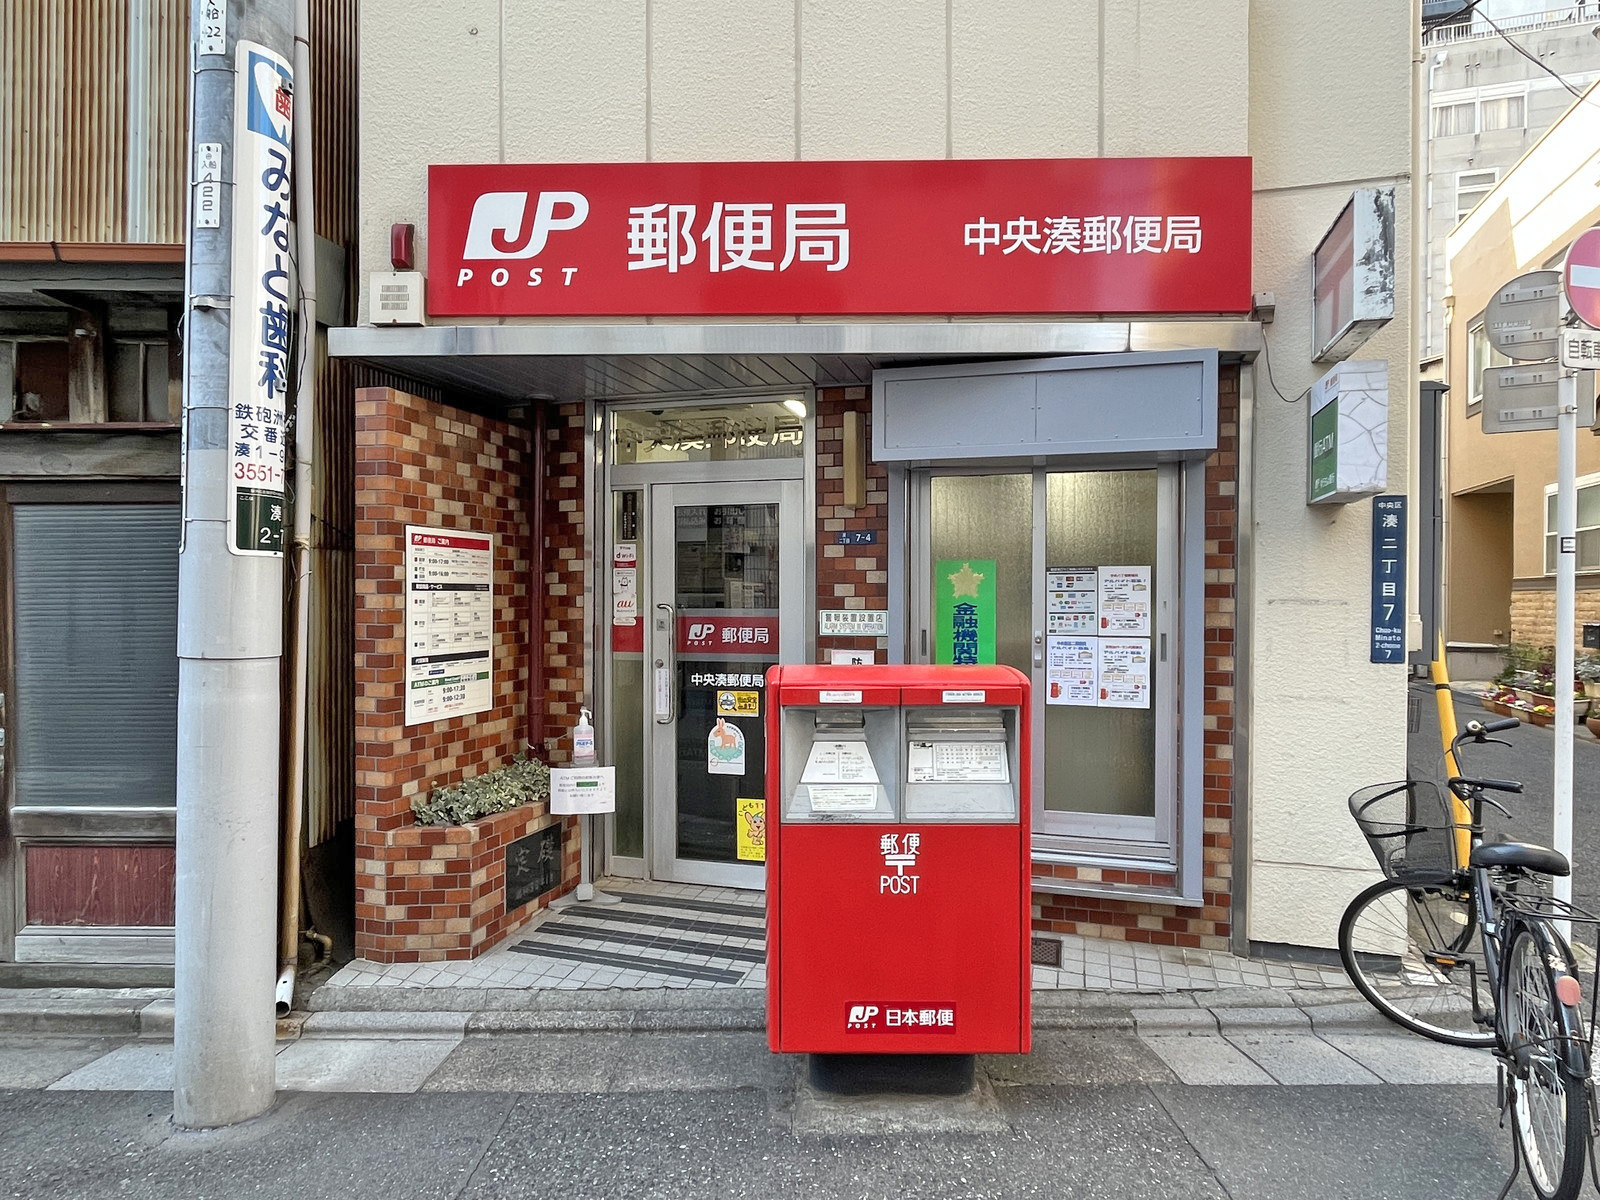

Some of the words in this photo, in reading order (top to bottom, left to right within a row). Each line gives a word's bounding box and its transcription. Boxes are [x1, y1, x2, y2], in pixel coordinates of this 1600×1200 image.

[627, 202, 850, 273] 郵便局
[964, 215, 1202, 255] 中央湊郵便局
[457, 268, 578, 287] POST
[1378, 501, 1402, 509] 中央区
[856, 533, 871, 542] 7-4
[616, 600, 634, 608] au
[824, 622, 838, 630] ALARM
[839, 622, 856, 630] SYSTEM
[862, 622, 884, 630] OPERATION
[721, 627, 769, 644] 郵便局
[1385, 649, 1392, 659] 7
[691, 673, 764, 688] 中央湊郵便局
[880, 833, 920, 855] 郵便
[880, 875, 920, 894] POST
[886, 1009, 954, 1026] 日本郵便
